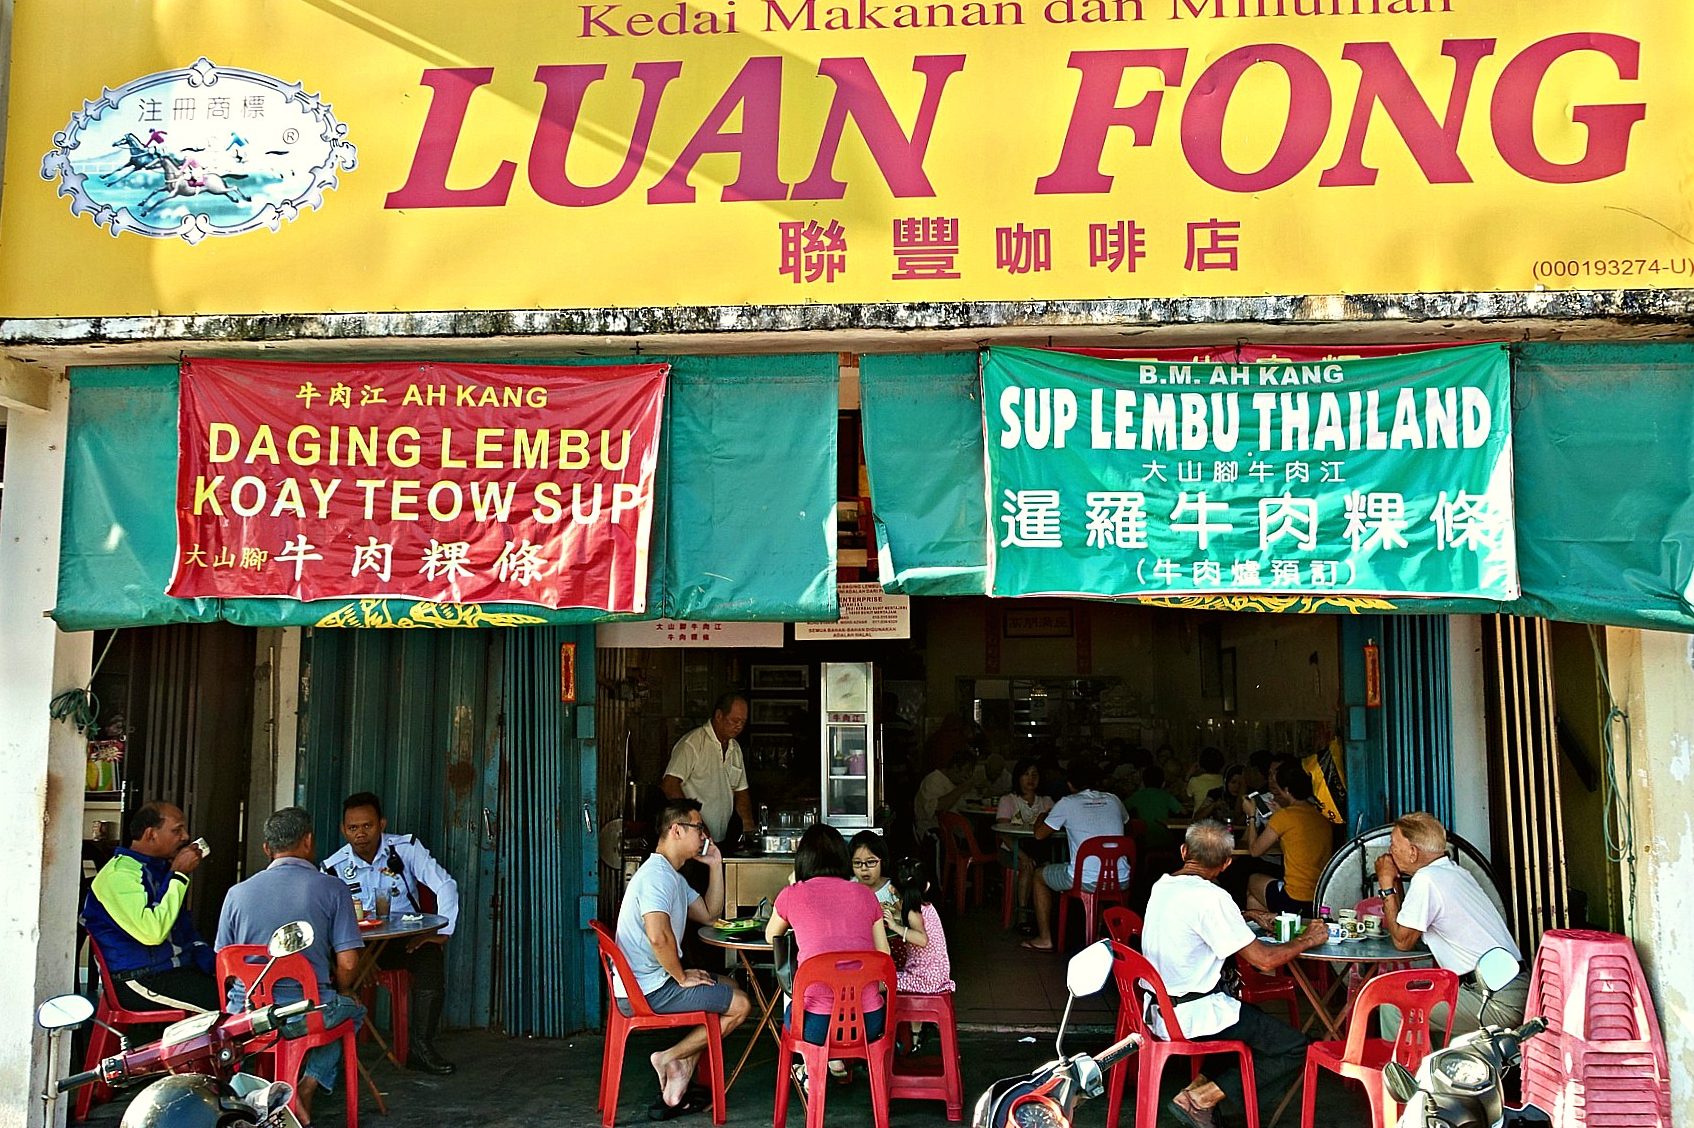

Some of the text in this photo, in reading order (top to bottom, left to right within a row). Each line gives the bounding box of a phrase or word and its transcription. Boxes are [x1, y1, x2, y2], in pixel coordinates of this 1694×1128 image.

[577, 0, 740, 38] Kedai
[762, 0, 1026, 32] Makanan
[1044, 0, 1144, 25] dan
[385, 31, 1647, 210] LUAN FONG
[779, 217, 1241, 284] 聯豐咖啡店
[1532, 257, 1694, 280] (000193274-U)
[295, 381, 549, 409] 牛肉江 AH KANG
[1138, 364, 1345, 386] B.M. AH KANG
[1000, 385, 1492, 453] SUP LEMBU THAILAND
[208, 421, 631, 472] DAGING LEMBU
[1141, 460, 1347, 483] 大山腳牛肉江
[193, 475, 642, 525] KOAY TEOW SUP
[1000, 488, 1500, 552] 暹羅牛肉粿條
[184, 532, 550, 584] 大山腳 牛肉粿條
